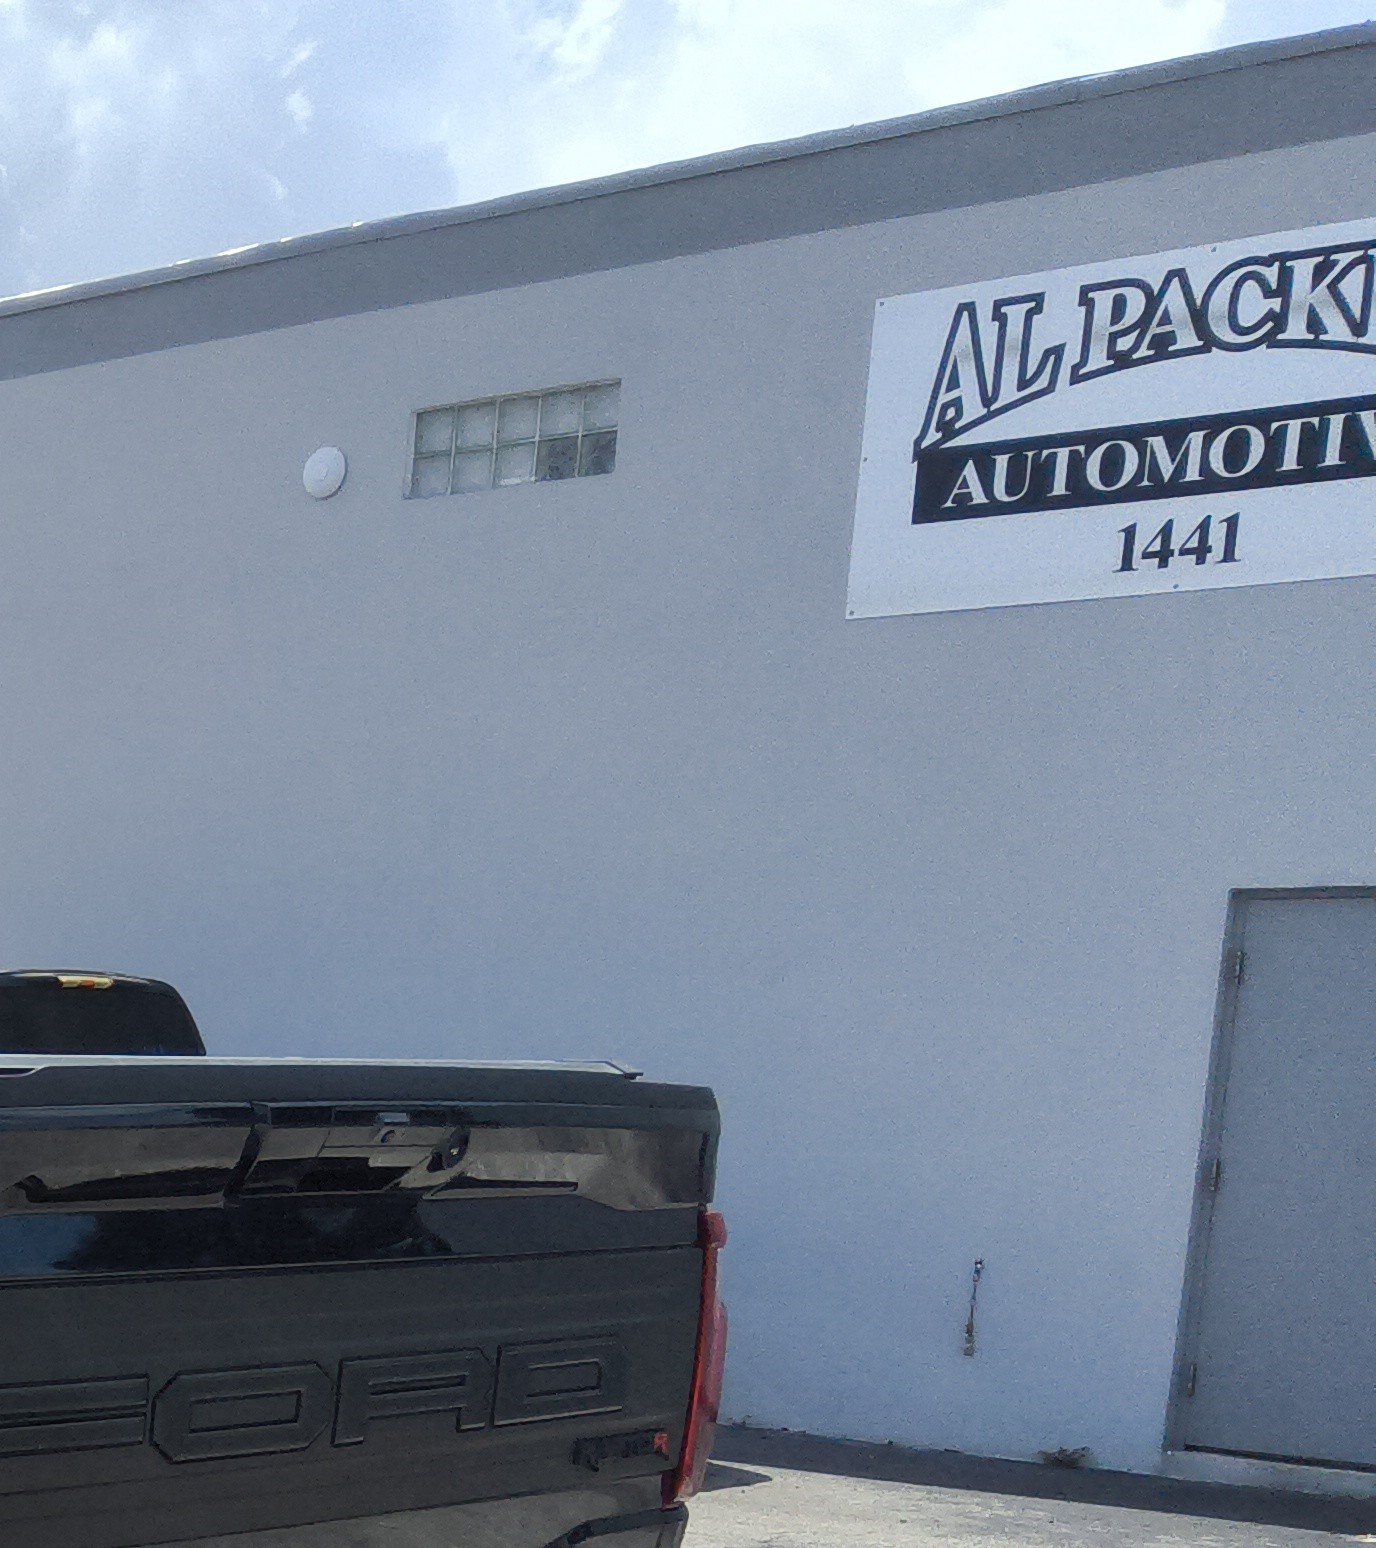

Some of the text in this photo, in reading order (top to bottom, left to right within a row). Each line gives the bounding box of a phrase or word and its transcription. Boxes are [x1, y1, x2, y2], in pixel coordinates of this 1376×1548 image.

[912, 239, 1376, 464] AL PACK
[1111, 511, 1242, 574] 1441
